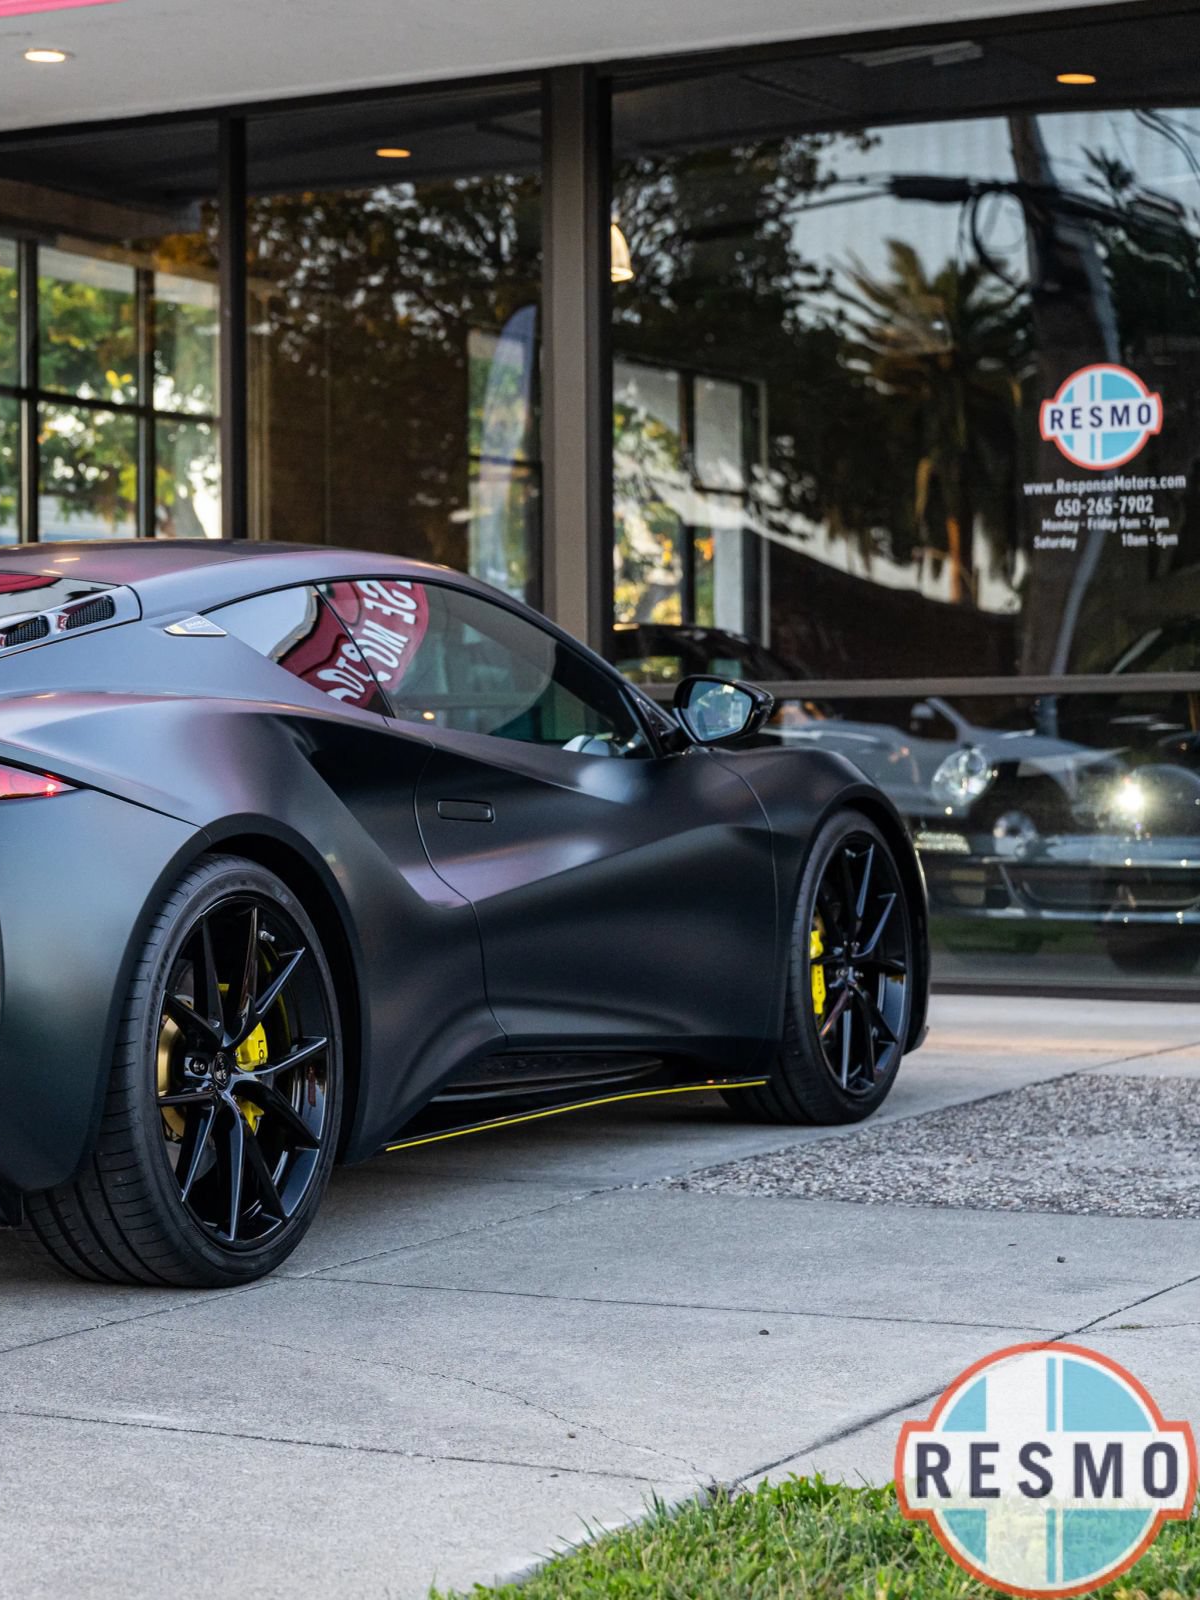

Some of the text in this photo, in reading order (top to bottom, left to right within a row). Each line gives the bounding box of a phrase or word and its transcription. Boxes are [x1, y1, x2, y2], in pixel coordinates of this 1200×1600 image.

[1050, 403, 1152, 431] RESMO
[1023, 475, 1186, 496] www.ResponseMotors.com
[1055, 495, 1154, 517] 650-265-7902
[1042, 518, 1079, 533] Monday
[1087, 517, 1118, 533] Friday
[1033, 536, 1078, 551] Saturday
